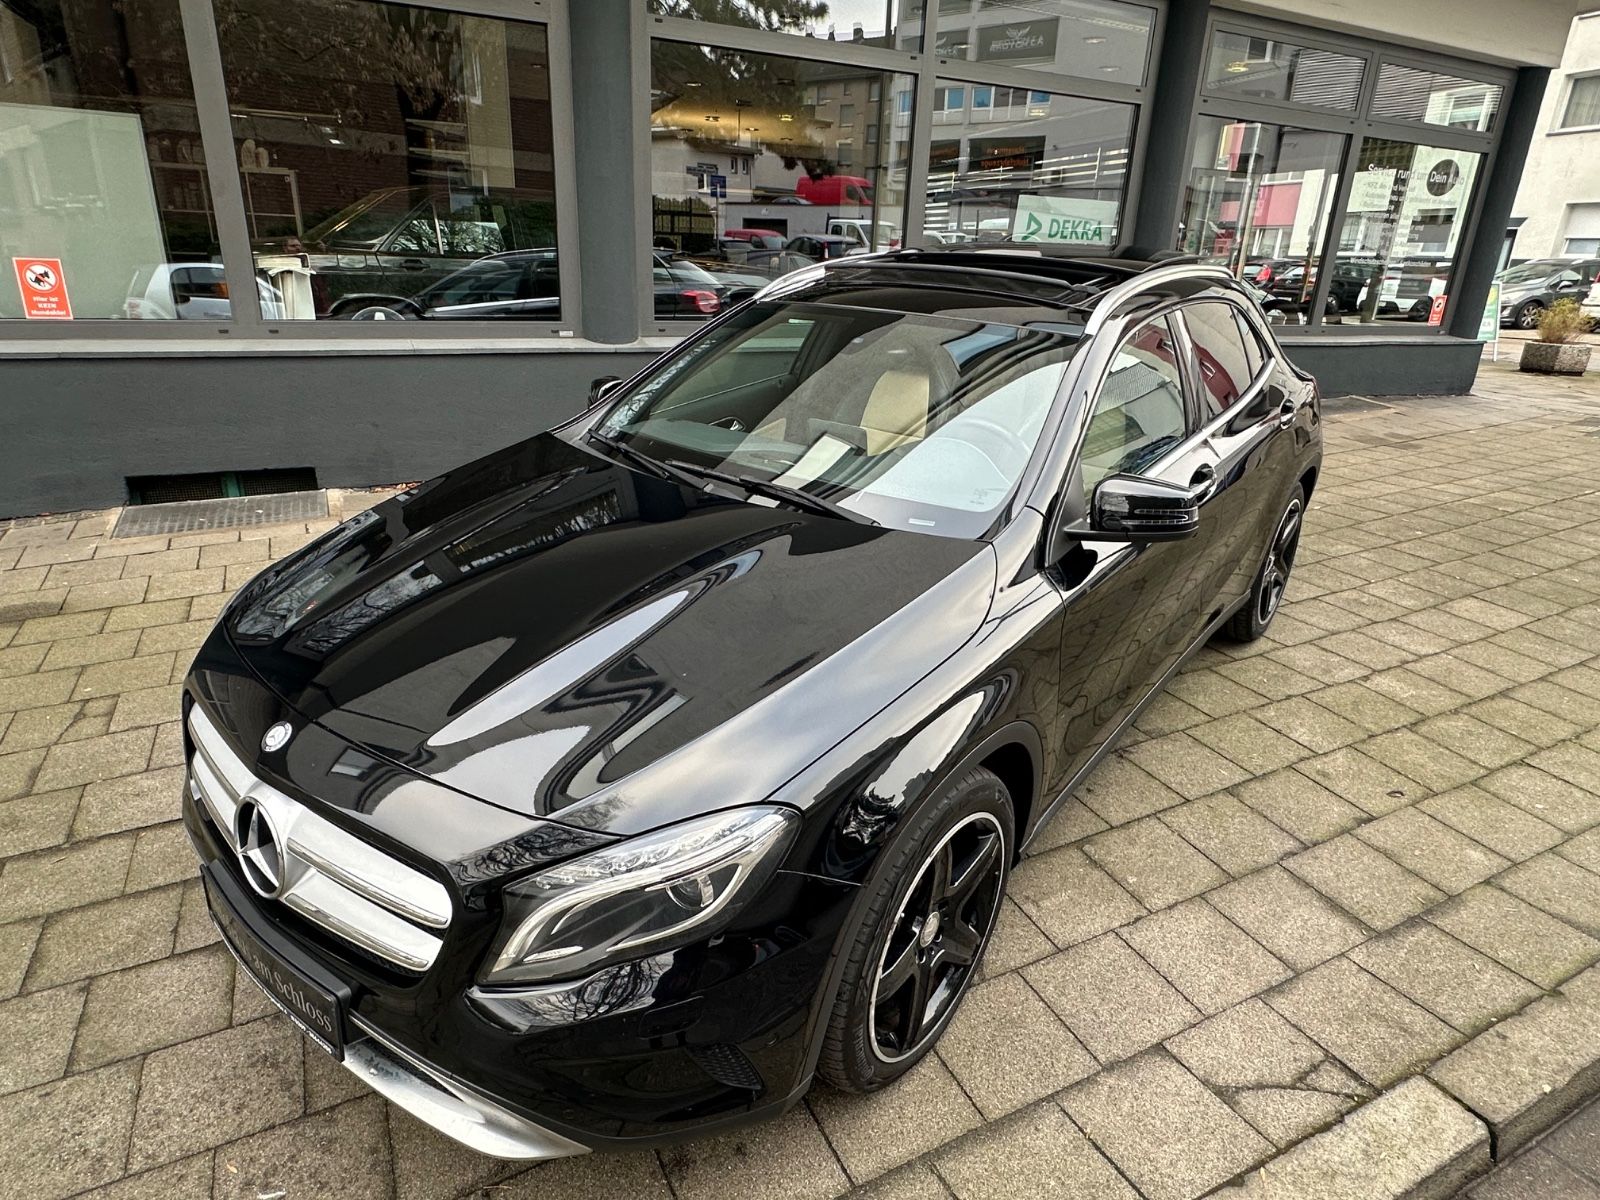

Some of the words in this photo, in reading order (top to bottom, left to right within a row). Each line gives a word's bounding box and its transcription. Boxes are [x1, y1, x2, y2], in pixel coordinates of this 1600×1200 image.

[1430, 171, 1448, 184] Dein
[1047, 219, 1103, 242] DEKRA
[274, 971, 332, 1032] Schloss
